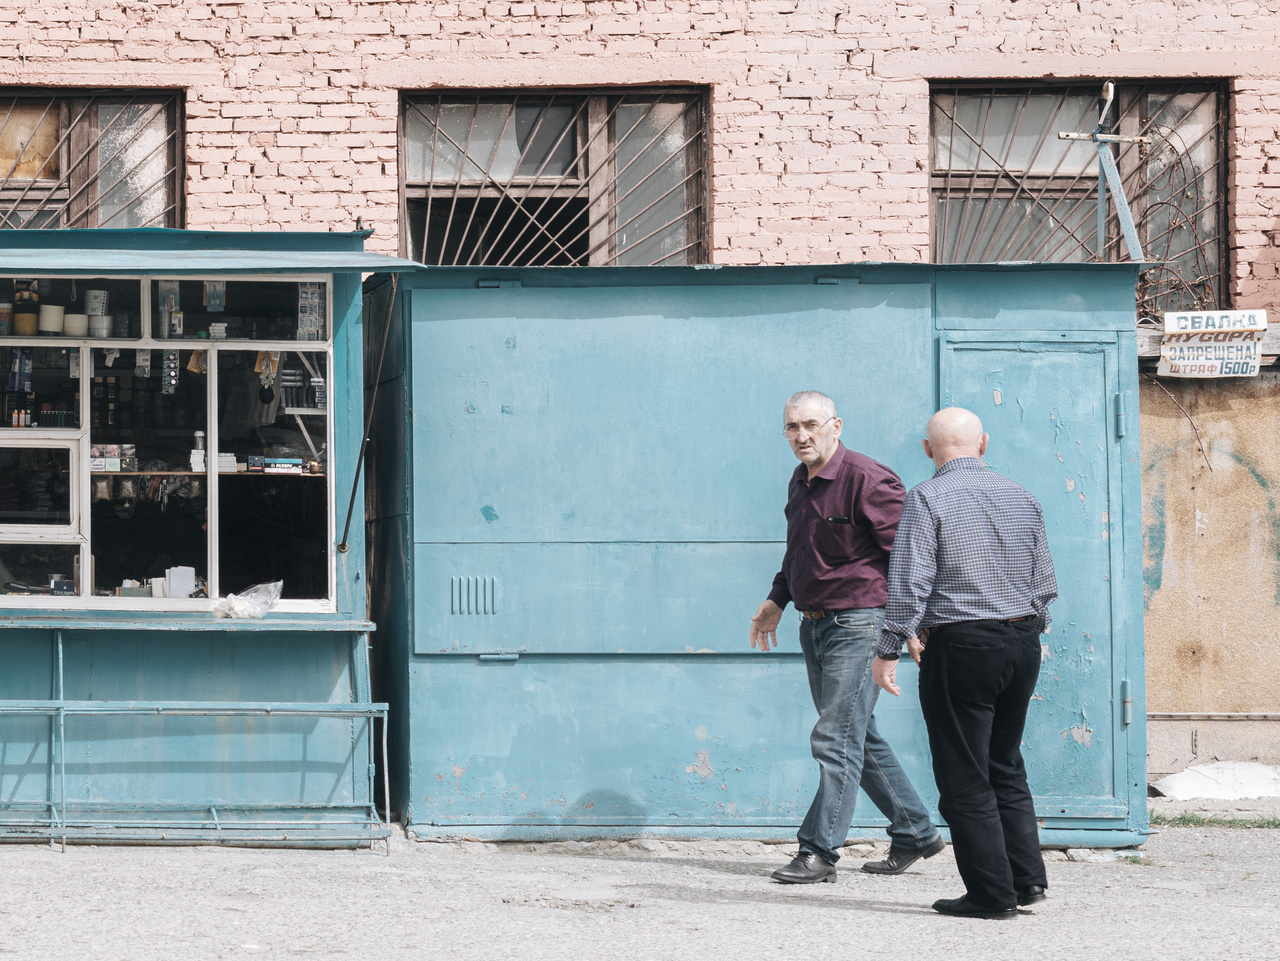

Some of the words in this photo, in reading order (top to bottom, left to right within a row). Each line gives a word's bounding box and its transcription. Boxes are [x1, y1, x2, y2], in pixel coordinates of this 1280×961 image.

[1166, 331, 1255, 343] МУСОРА
[1169, 342, 1258, 361] ЗАПРЕЩЕНА!
[1169, 363, 1218, 375] ШТРАФ
